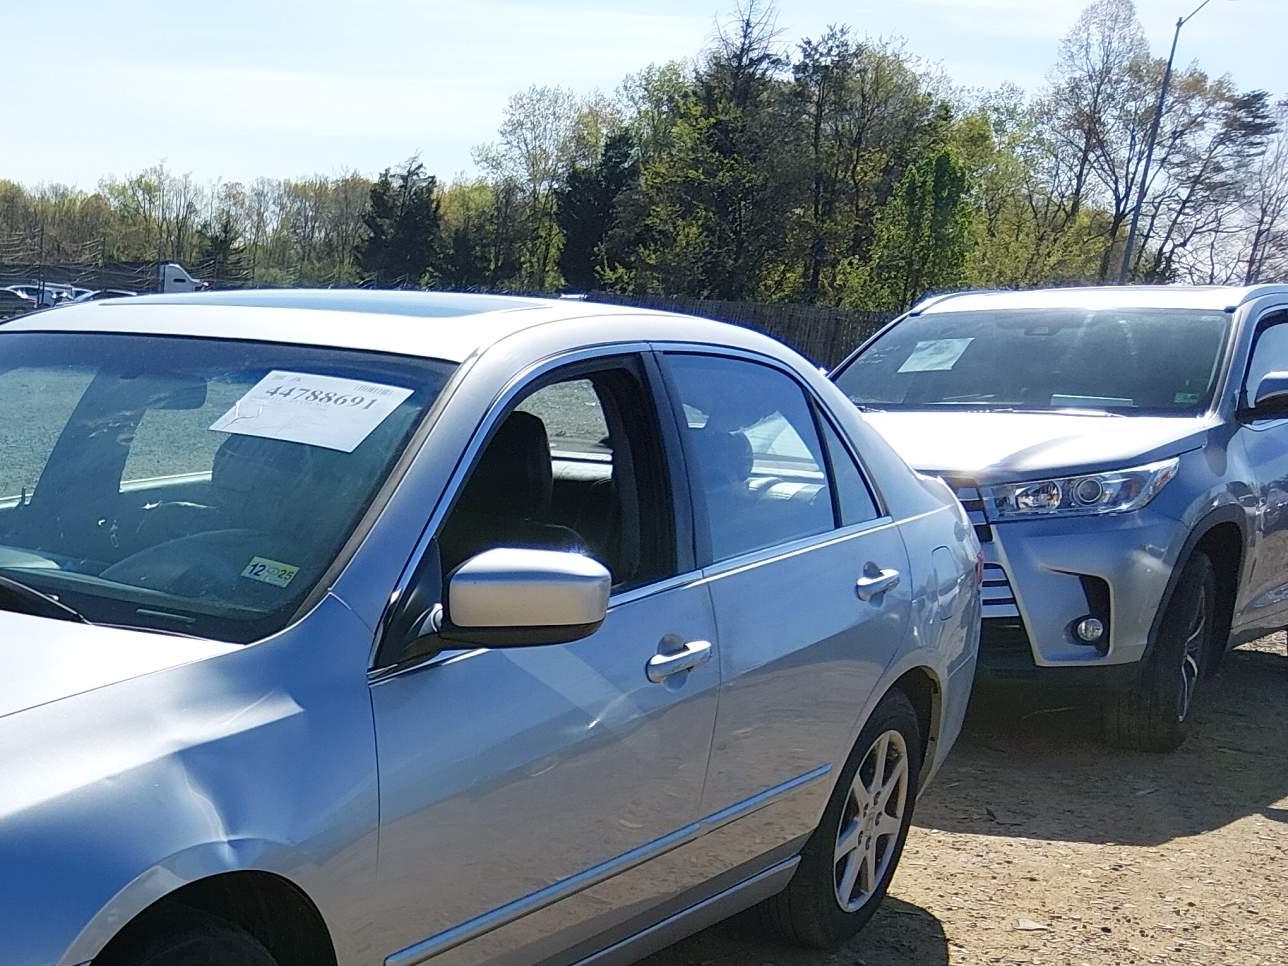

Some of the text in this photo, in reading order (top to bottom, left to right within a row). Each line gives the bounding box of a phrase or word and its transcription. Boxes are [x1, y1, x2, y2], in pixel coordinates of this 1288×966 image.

[265, 385, 378, 410] 44788691
[248, 562, 294, 580] 12 25
